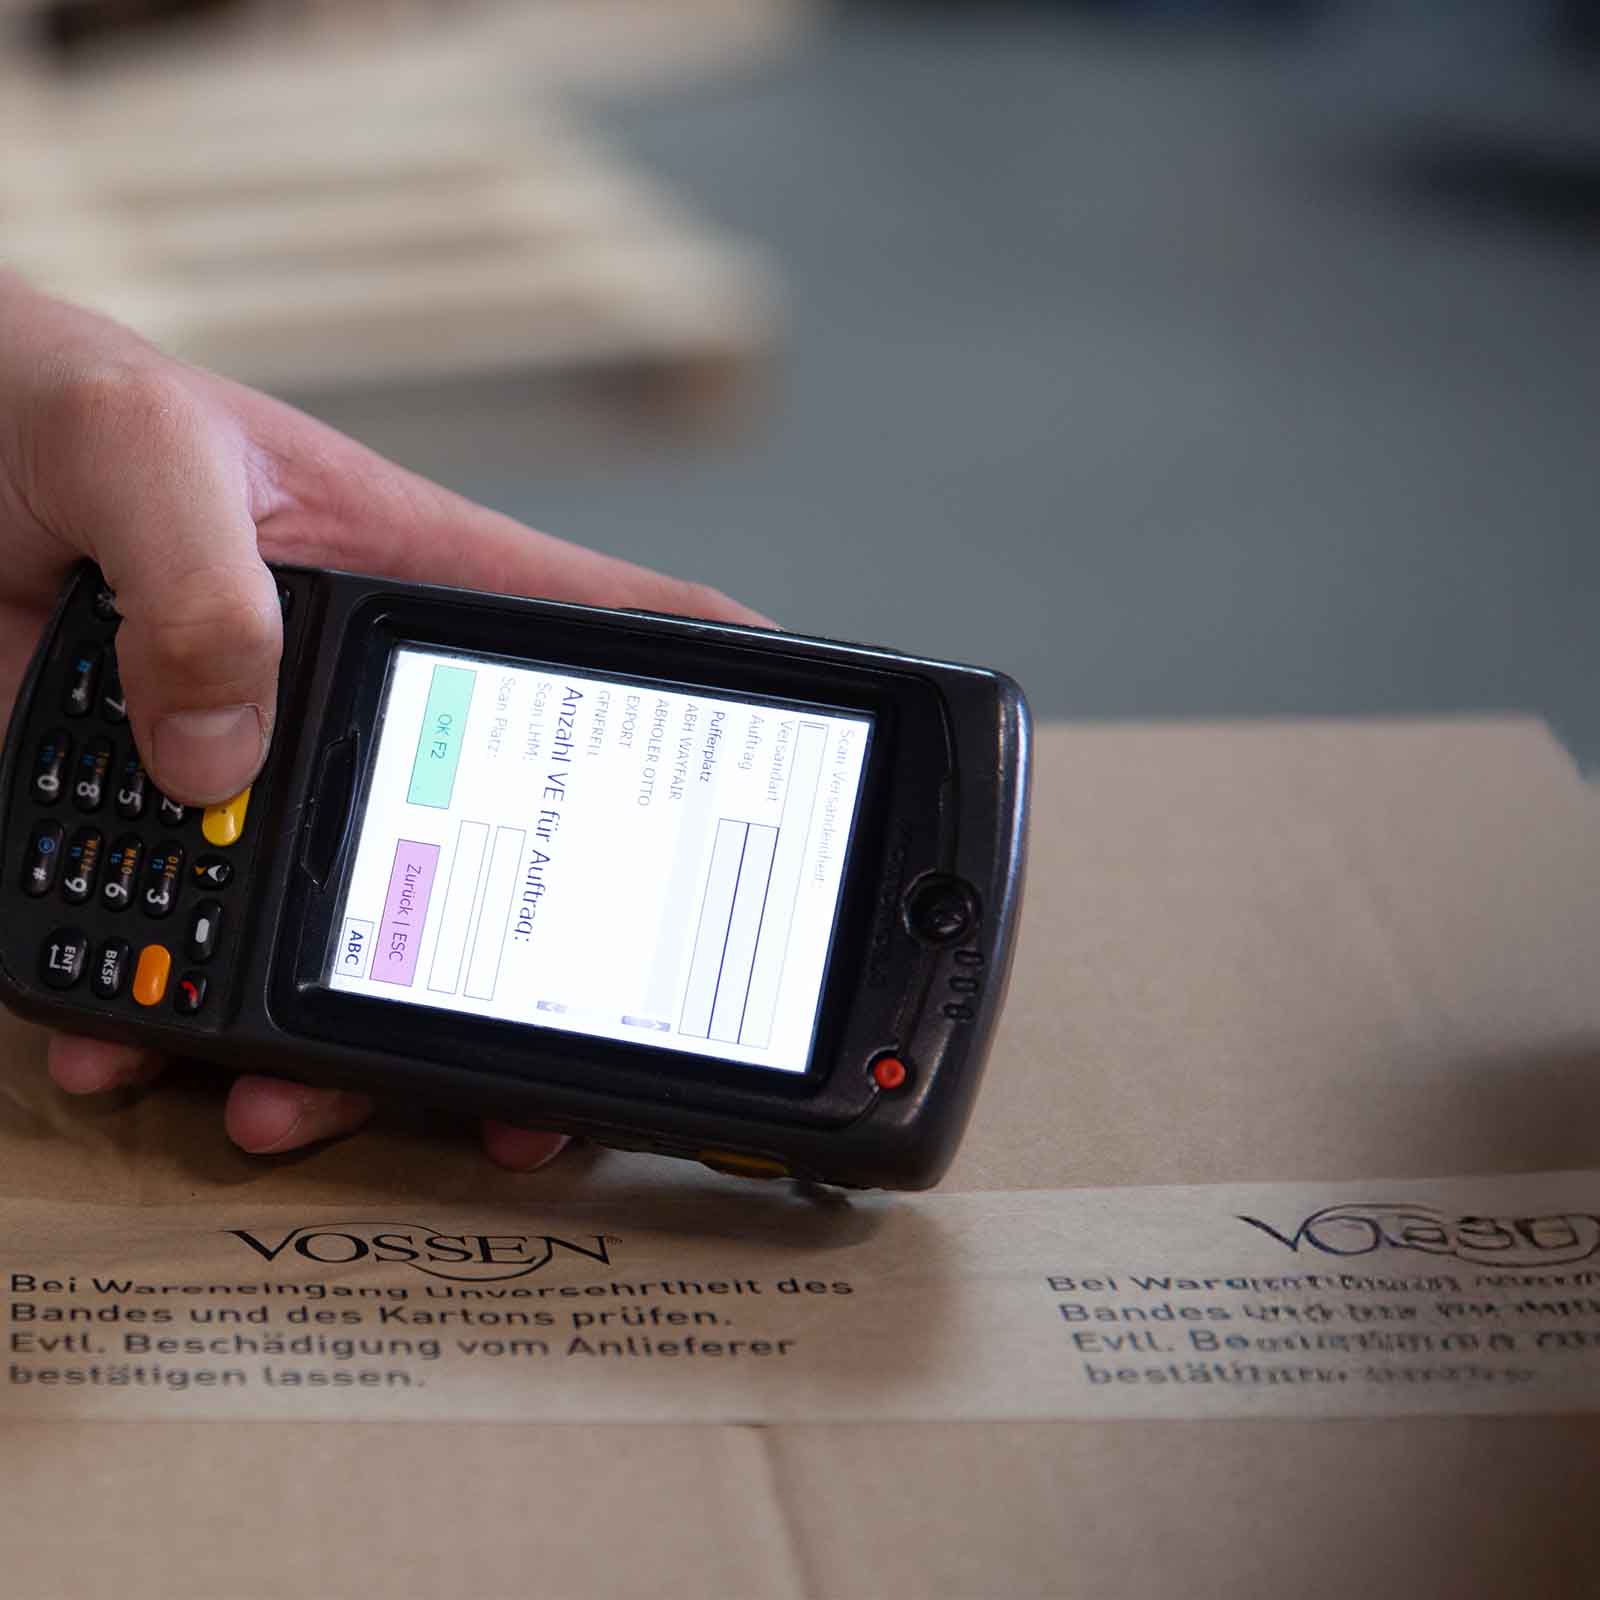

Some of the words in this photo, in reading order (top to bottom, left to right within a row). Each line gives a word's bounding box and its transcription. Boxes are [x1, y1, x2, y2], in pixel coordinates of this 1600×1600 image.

[495, 675, 517, 712] Scan
[531, 681, 553, 718] Scan
[435, 713, 453, 736] OK
[550, 685, 584, 763] Anzahl
[618, 694, 640, 749] EXPORT
[645, 697, 670, 763] ABHOLER
[682, 702, 700, 733] ABH
[430, 739, 447, 761] F2
[698, 710, 726, 785] Pufferplatz
[737, 713, 766, 772] Auftrag
[833, 728, 856, 765] Scan
[668, 736, 692, 801] WAYFAIR
[765, 719, 795, 804] Versandart
[37, 774, 60, 792] 0
[77, 780, 100, 800] 8
[118, 789, 142, 808] 5
[543, 771, 569, 803] VE
[637, 767, 655, 807] OTTO
[161, 798, 184, 821] 2
[535, 808, 561, 844] für
[65, 876, 88, 893] 9
[105, 882, 128, 899] 6
[146, 888, 169, 905] 3
[397, 862, 423, 916] Zurück
[60, 945, 78, 974] ENT
[344, 929, 363, 967] ABC
[388, 932, 409, 963] ESC
[102, 948, 119, 986] BKSP
[10, 1273, 77, 1295] Bei
[90, 1276, 409, 1300] Wareneingang
[424, 1278, 762, 1300] Unversehrtheit
[775, 1276, 855, 1296] des
[10, 1302, 174, 1324] Bandes
[189, 1304, 270, 1325] und
[285, 1304, 363, 1326] des
[377, 1305, 556, 1328] Kartons
[570, 1305, 733, 1331] prüfen.
[1057, 1302, 1233, 1323] Bandes
[9, 1331, 107, 1355] Evtl.
[122, 1330, 441, 1361] Beschädigung
[455, 1340, 551, 1358] vom
[565, 1335, 799, 1359] Anlieferer
[8, 1363, 248, 1392] bestätigen
[261, 1365, 427, 1390] lassen.
